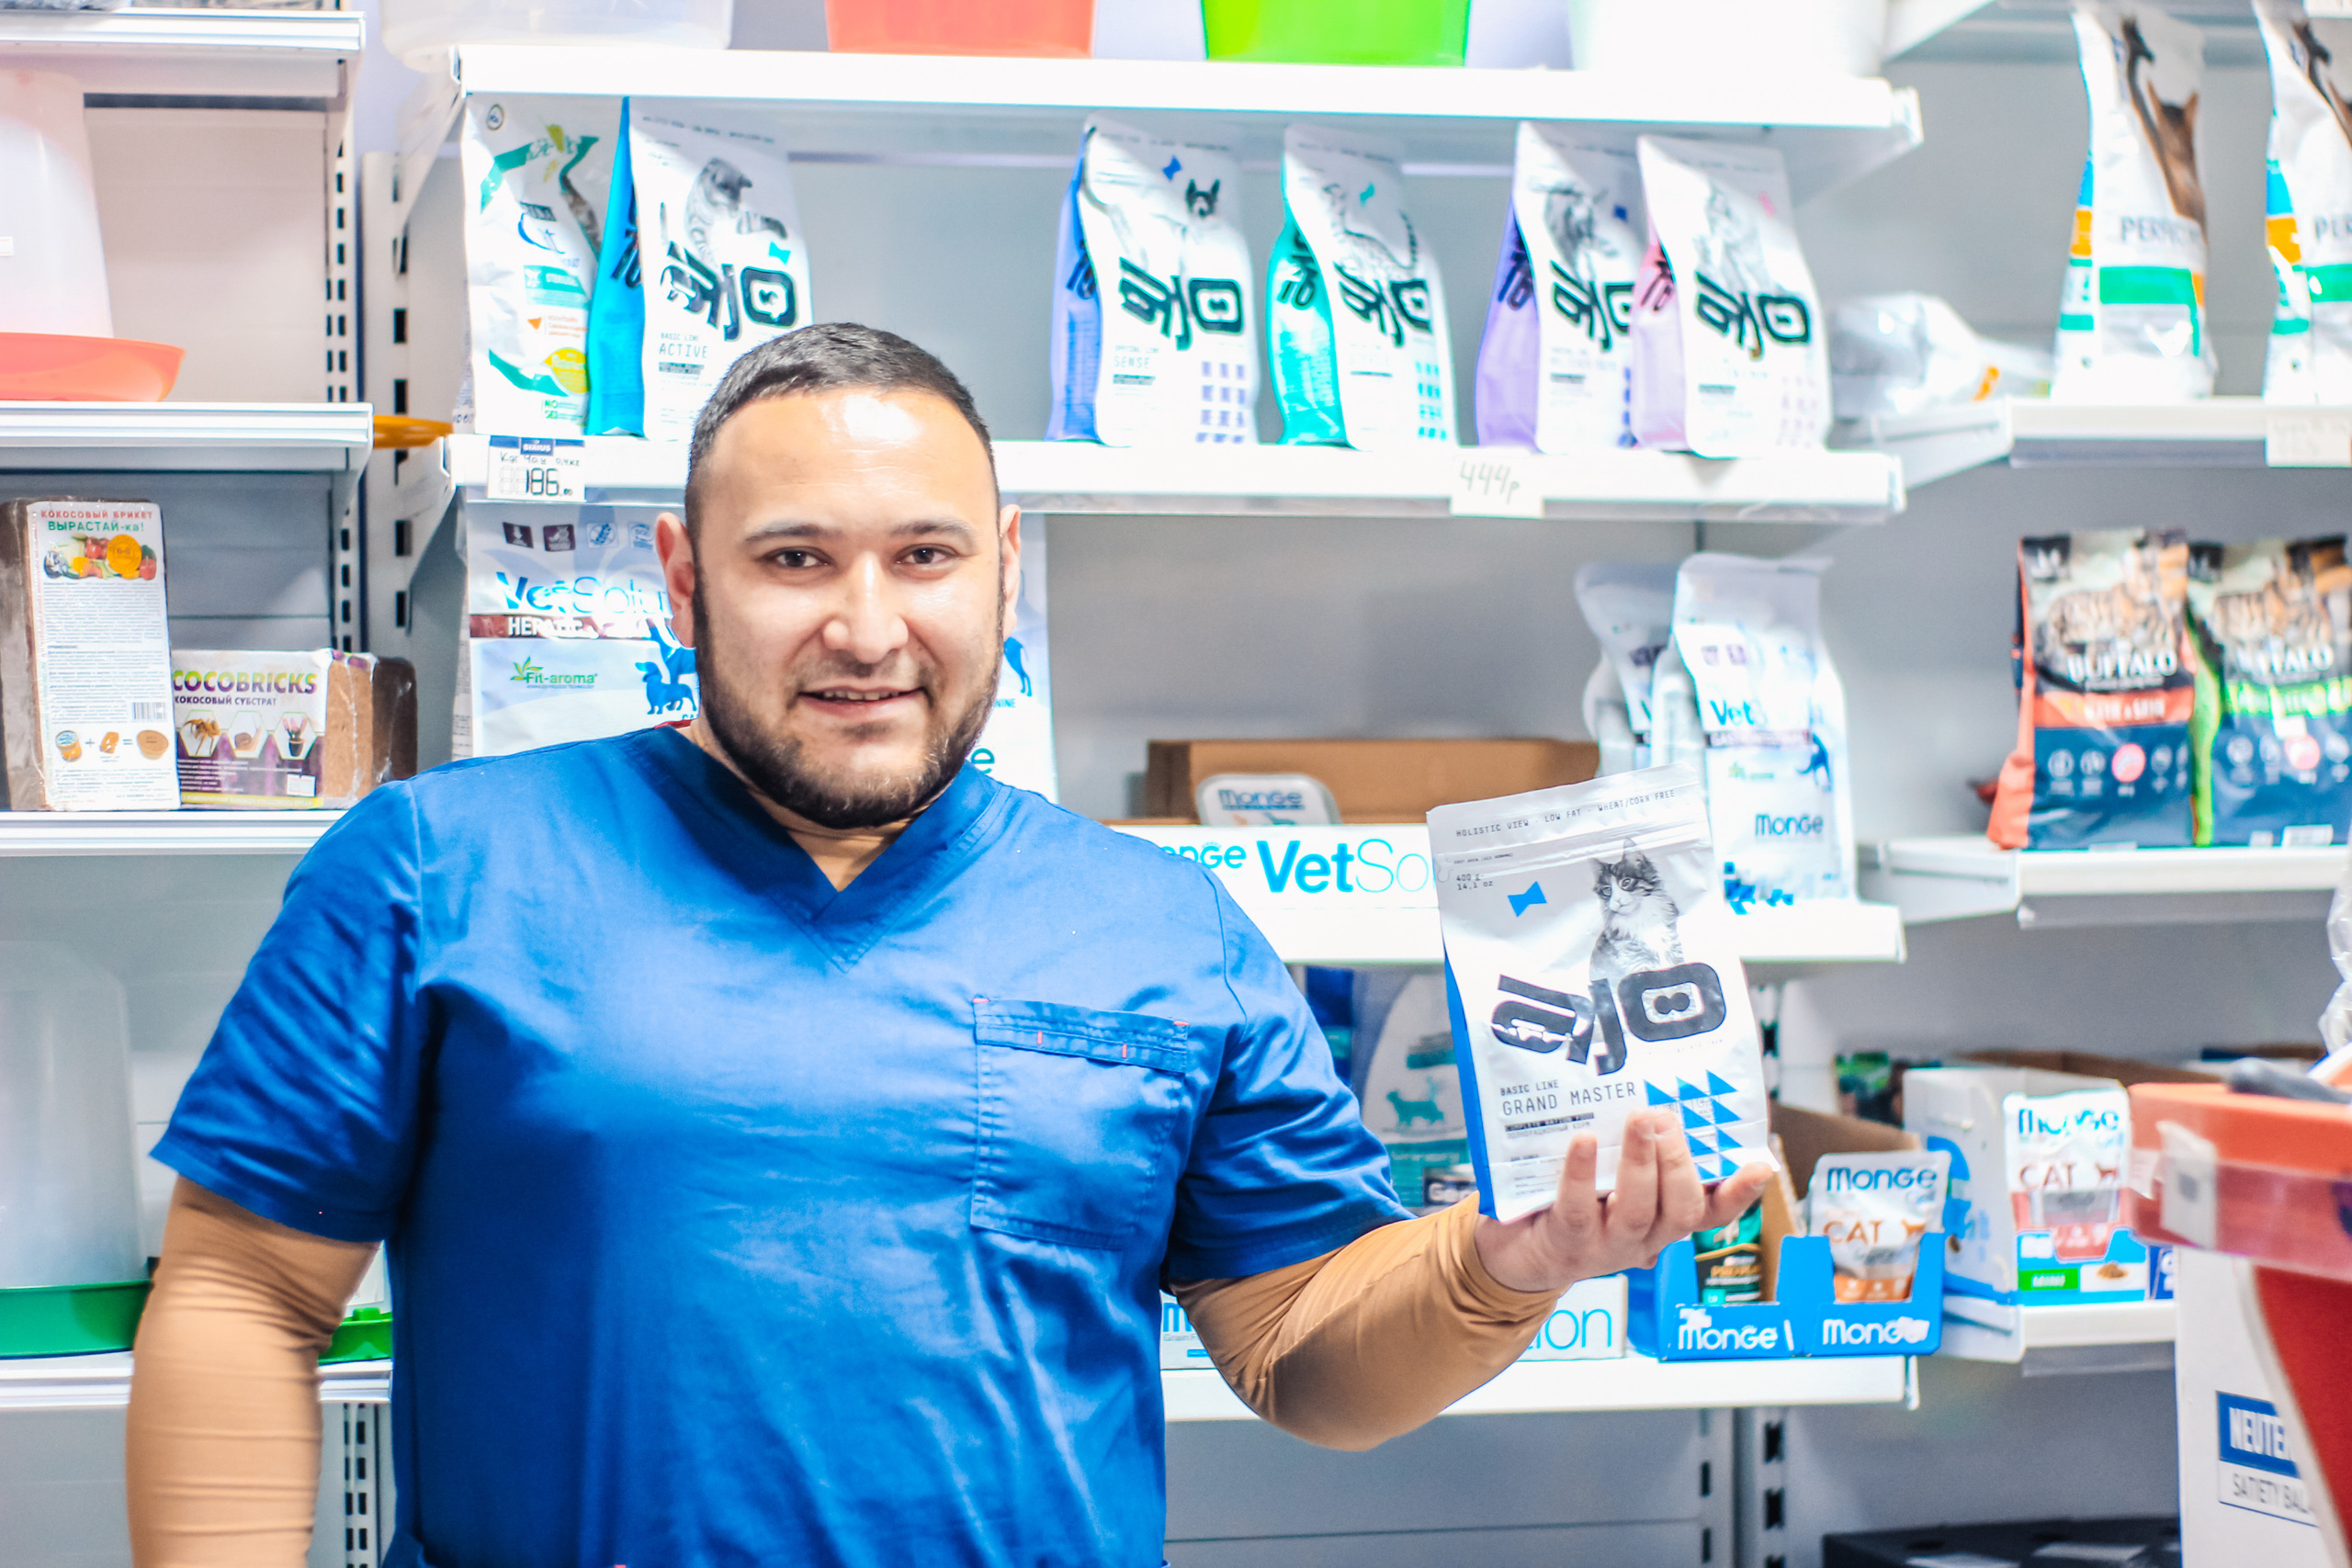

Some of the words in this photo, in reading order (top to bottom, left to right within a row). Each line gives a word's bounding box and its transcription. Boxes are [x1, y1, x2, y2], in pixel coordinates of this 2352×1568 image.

[659, 343, 708, 358] ACTIVE
[1114, 355, 1150, 369] SENSE
[41, 510, 108, 519] КОКОСОВЫЙ
[113, 511, 153, 519] БРИКЕТ
[173, 670, 318, 694] COCOBRICKS
[235, 696, 277, 706] СУБСТРАТ
[1456, 824, 1501, 838] HOLISTIC
[1507, 819, 1529, 830] VIEW
[1544, 813, 1561, 823] LOW
[1566, 808, 1581, 818] FAT
[1598, 796, 1650, 813] WHEAT/CORN
[1655, 789, 1676, 800] FREE
[1456, 874, 1471, 882] 400
[1500, 1084, 1530, 1097] BASIC
[1535, 1079, 1559, 1091] LINE
[1502, 1094, 1558, 1116] GRAND
[1570, 1081, 1636, 1106] MASTER
[2020, 1164, 2075, 1190] CAT
[1823, 1221, 1883, 1245] CAT
[2229, 1406, 2293, 1461] NEUTE
